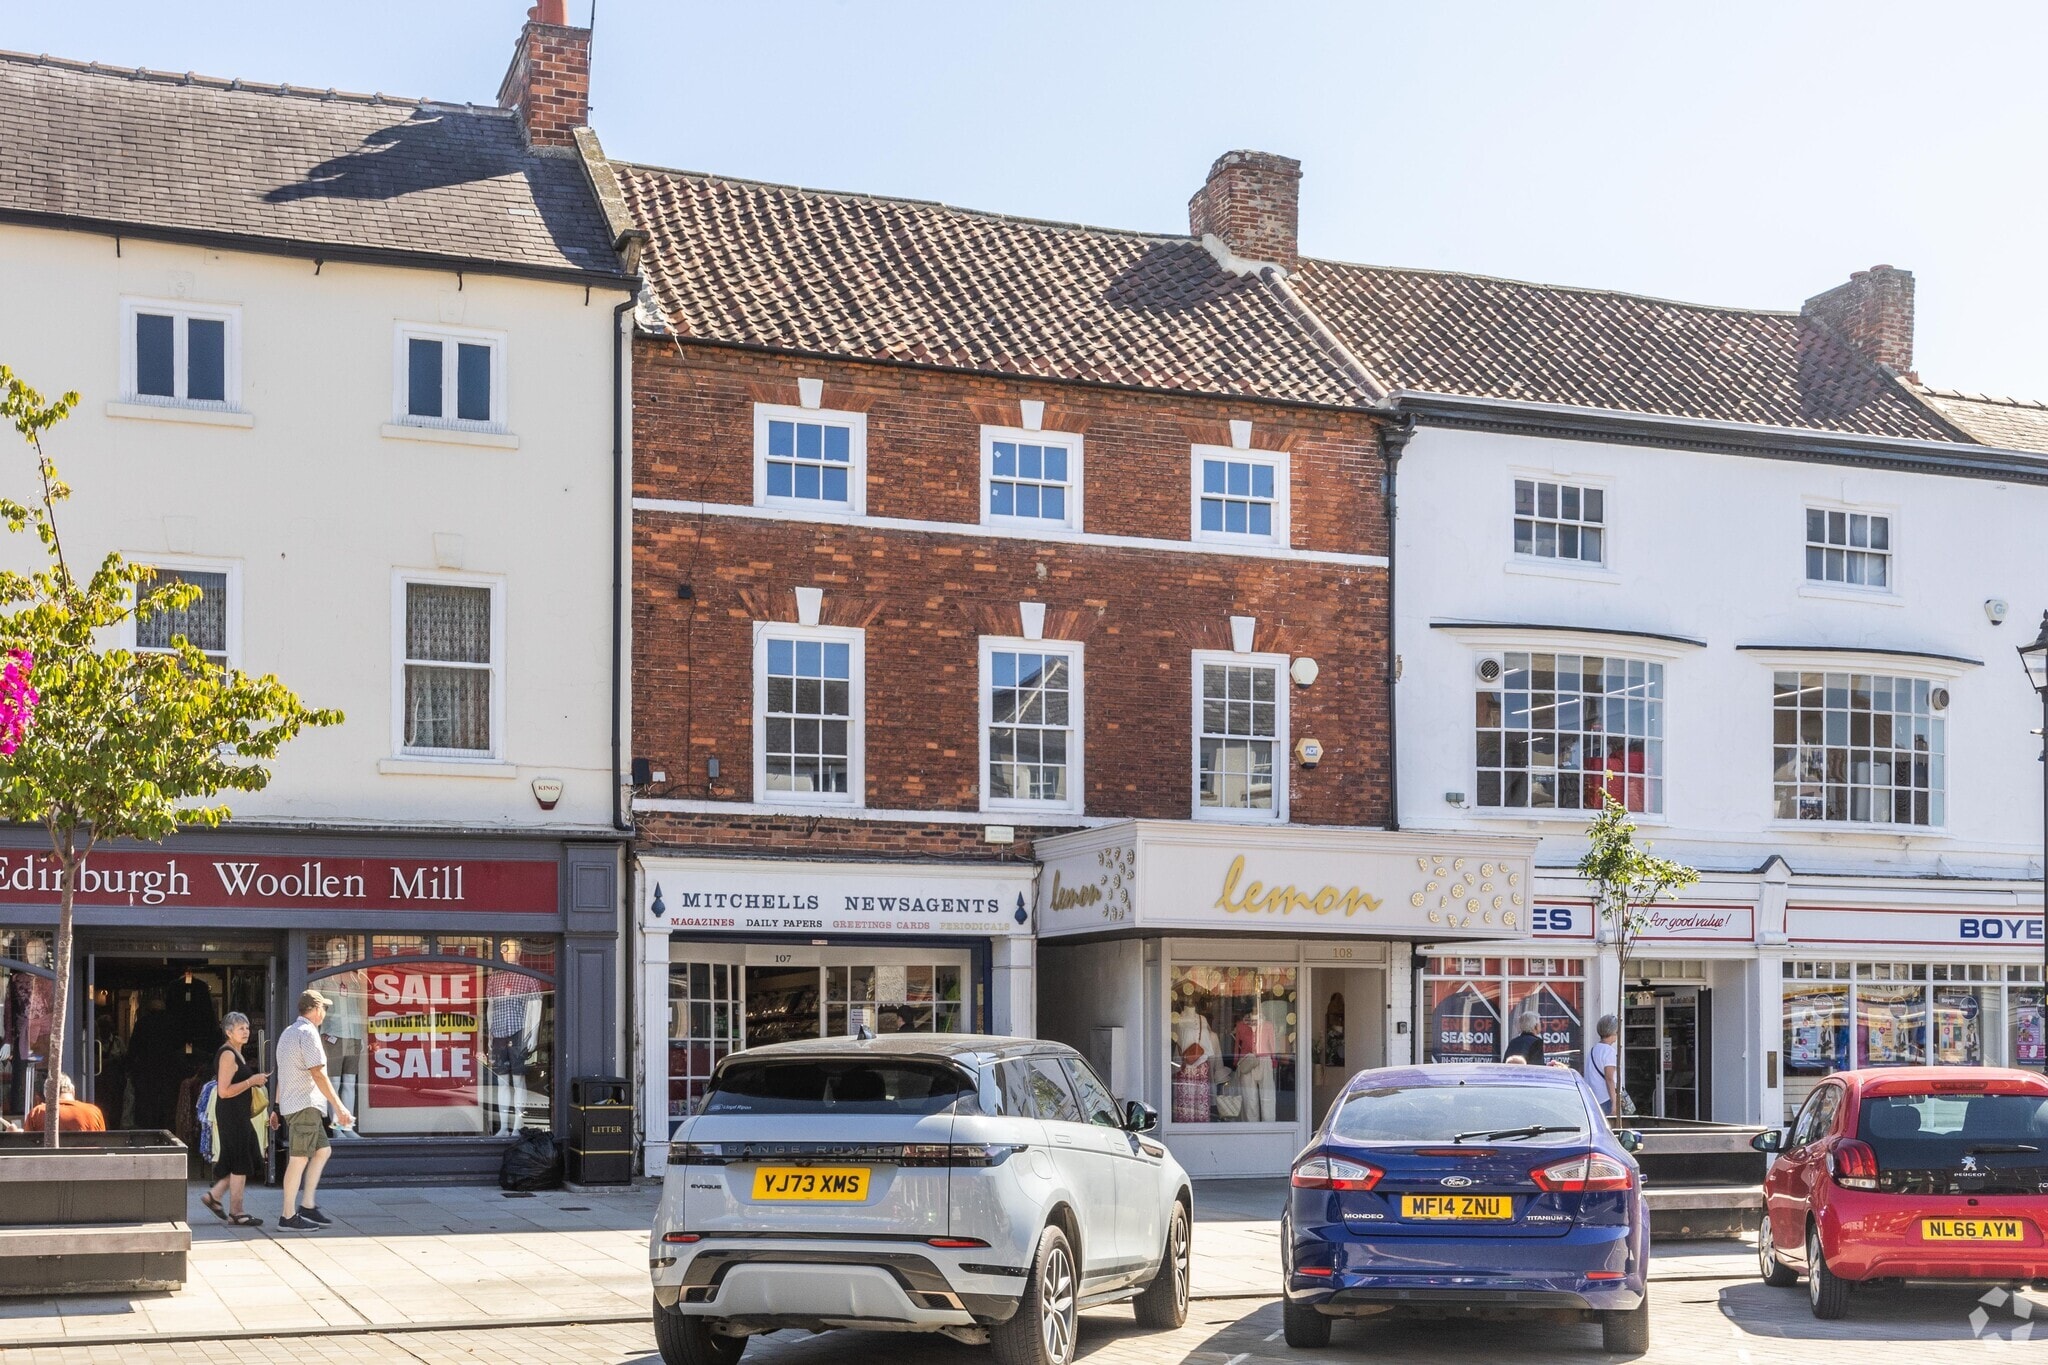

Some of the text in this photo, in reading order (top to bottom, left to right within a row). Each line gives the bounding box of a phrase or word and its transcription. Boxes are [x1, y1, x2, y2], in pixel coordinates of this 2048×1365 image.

[213, 861, 365, 898] Woollen
[390, 866, 465, 900] Mill
[1214, 854, 1383, 917] lemon
[1050, 869, 1102, 911] lemon
[682, 892, 999, 914] MITCHELLS NEWSAGENTS
[671, 917, 1010, 931] MAGAZINES DAILY PAPERS GREETINGS CARDS PERIODICALS
[1650, 911, 1731, 931] for good value!
[775, 954, 792, 963] 107
[1333, 948, 1353, 958] 108
[373, 973, 471, 1005] SALE
[370, 1016, 413, 1028] FURTHER
[415, 1014, 475, 1028] REDUCTIONS
[1474, 1018, 1493, 1031] OF
[1441, 1032, 1493, 1044] SEASON
[374, 1047, 471, 1078] SALE
[728, 1145, 801, 1153] RANGE
[765, 1174, 860, 1193] YJ73 XMS
[1446, 1178, 1466, 1186] Ford
[1412, 1198, 1499, 1215] MF14 ZNU
[1930, 1222, 2016, 1237] NL66 AYM
